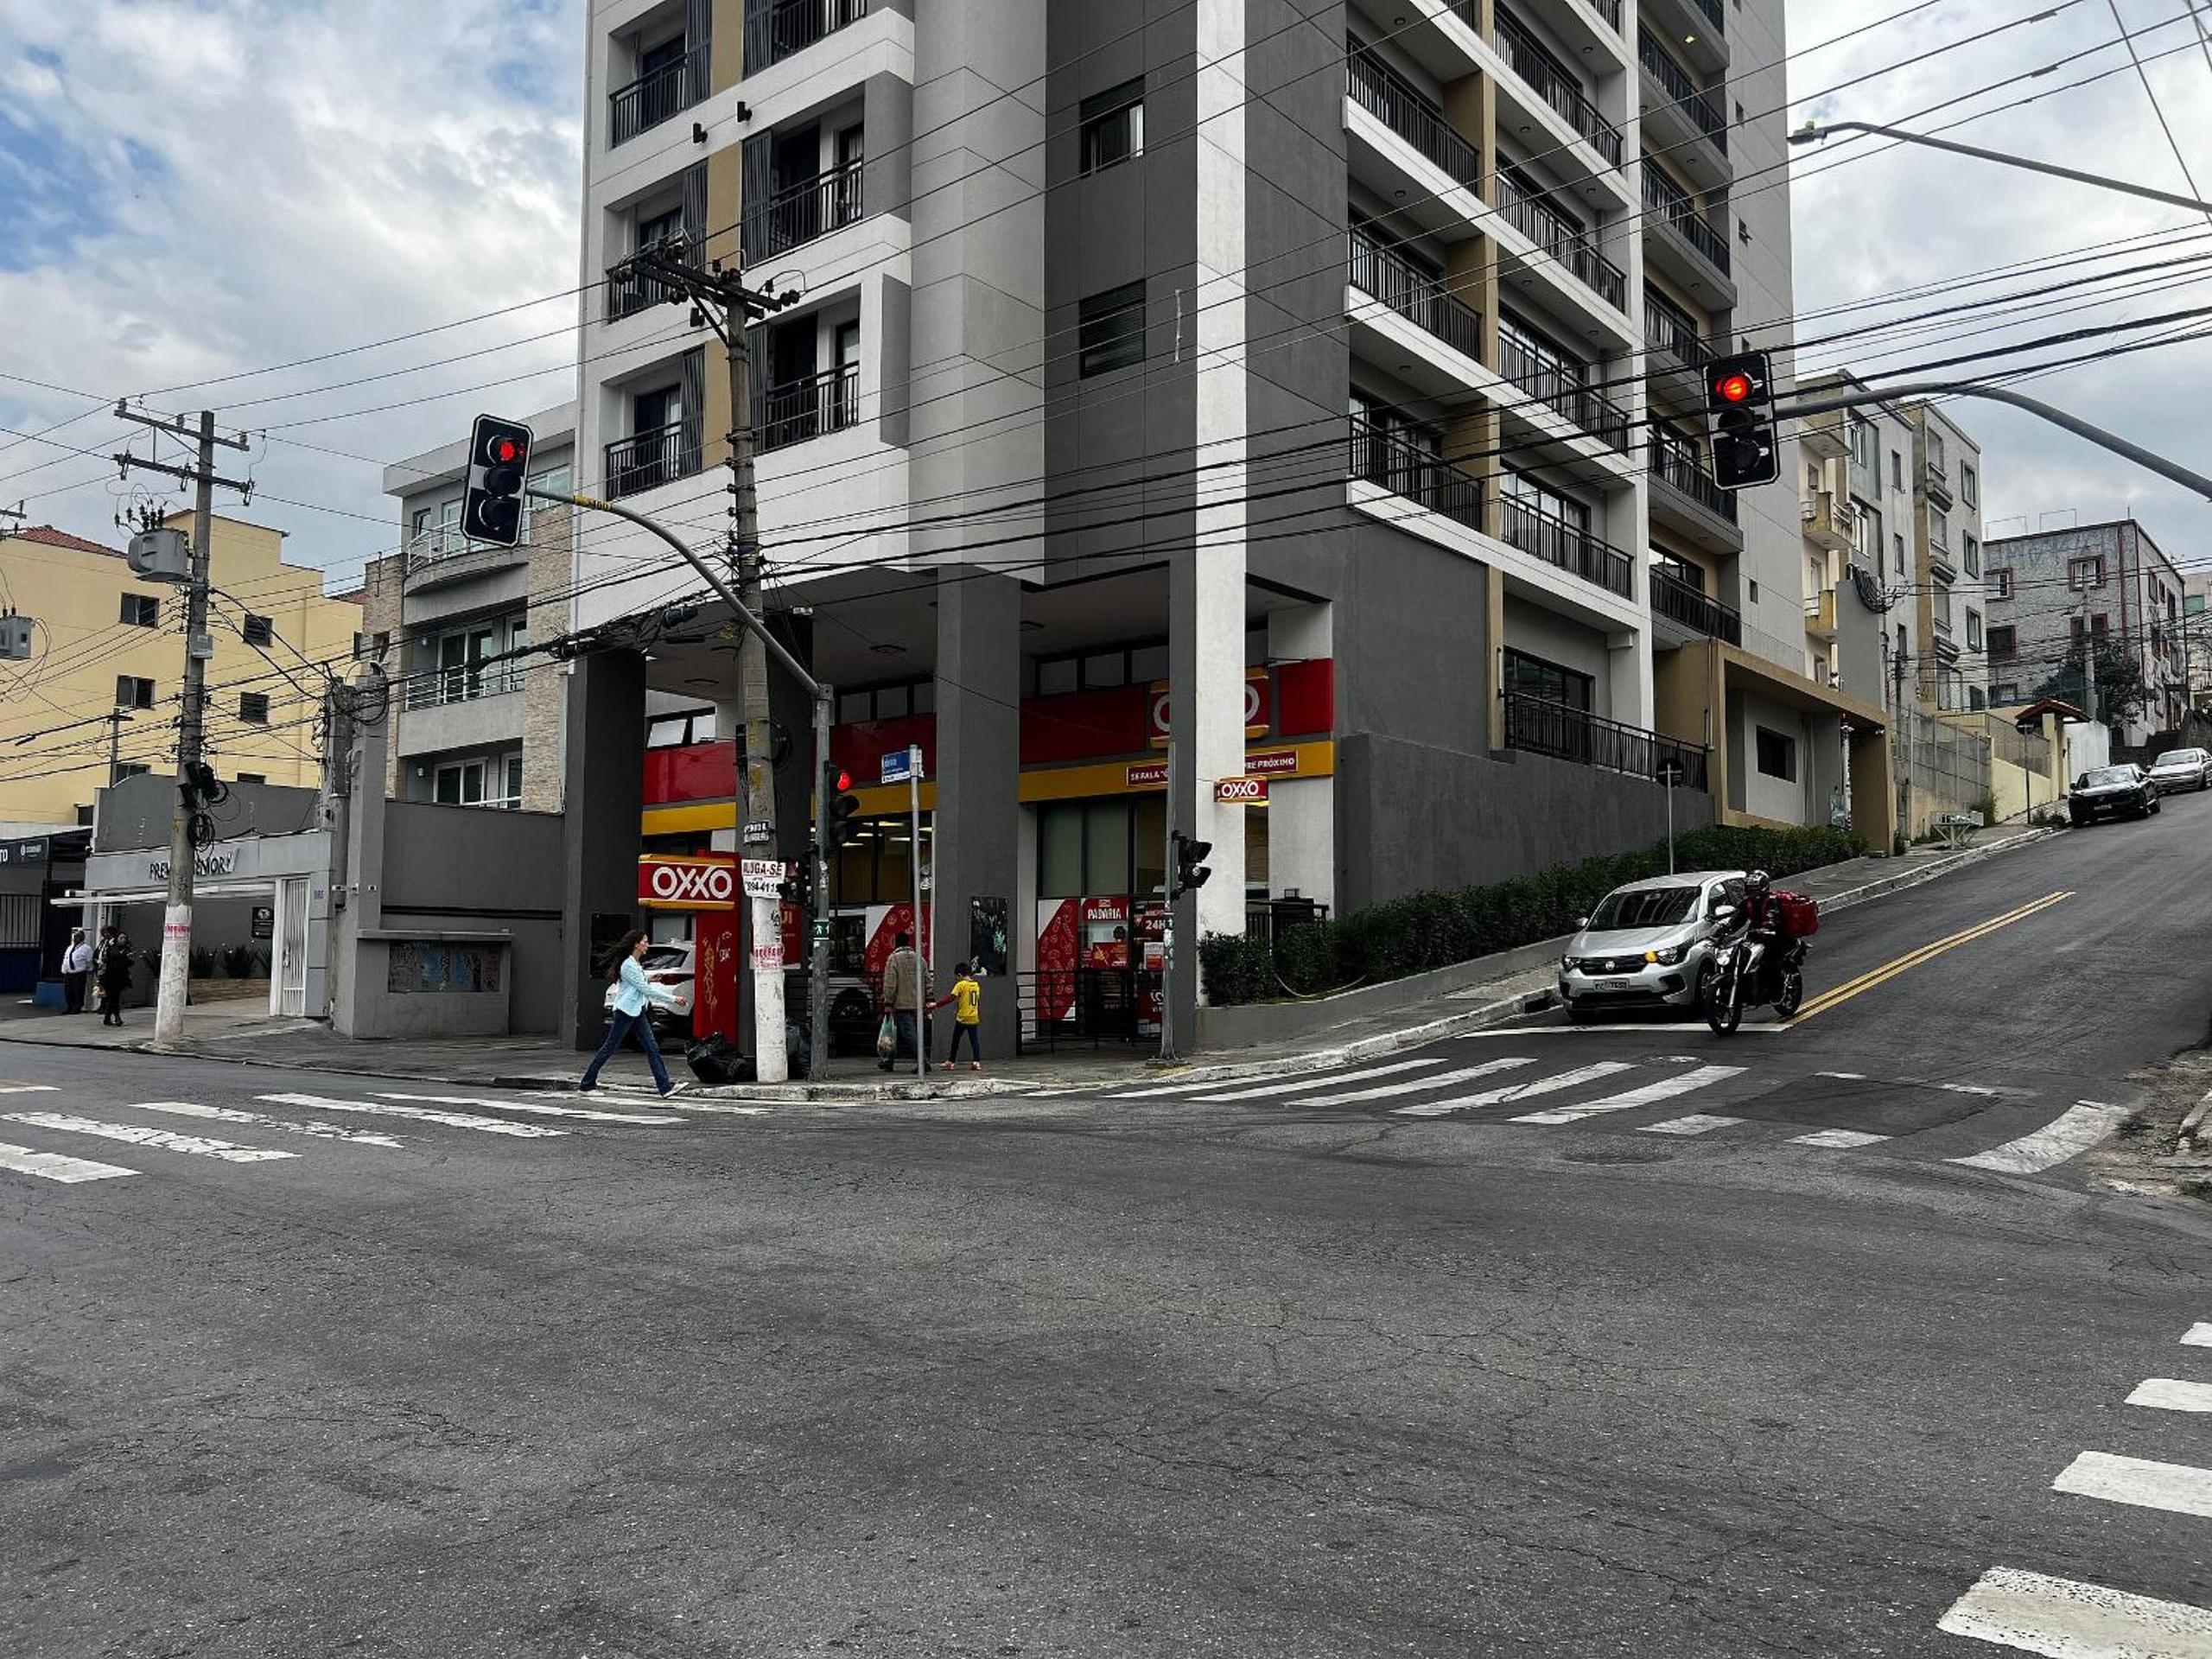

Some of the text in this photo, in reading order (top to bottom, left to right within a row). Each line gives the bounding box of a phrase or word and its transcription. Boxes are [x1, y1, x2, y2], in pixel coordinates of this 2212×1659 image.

[1258, 758, 1295, 769] PRÓXIMO
[1222, 779, 1259, 798] OXXO
[652, 866, 732, 899] OXXO
[1088, 907, 1122, 920] PADARIA
